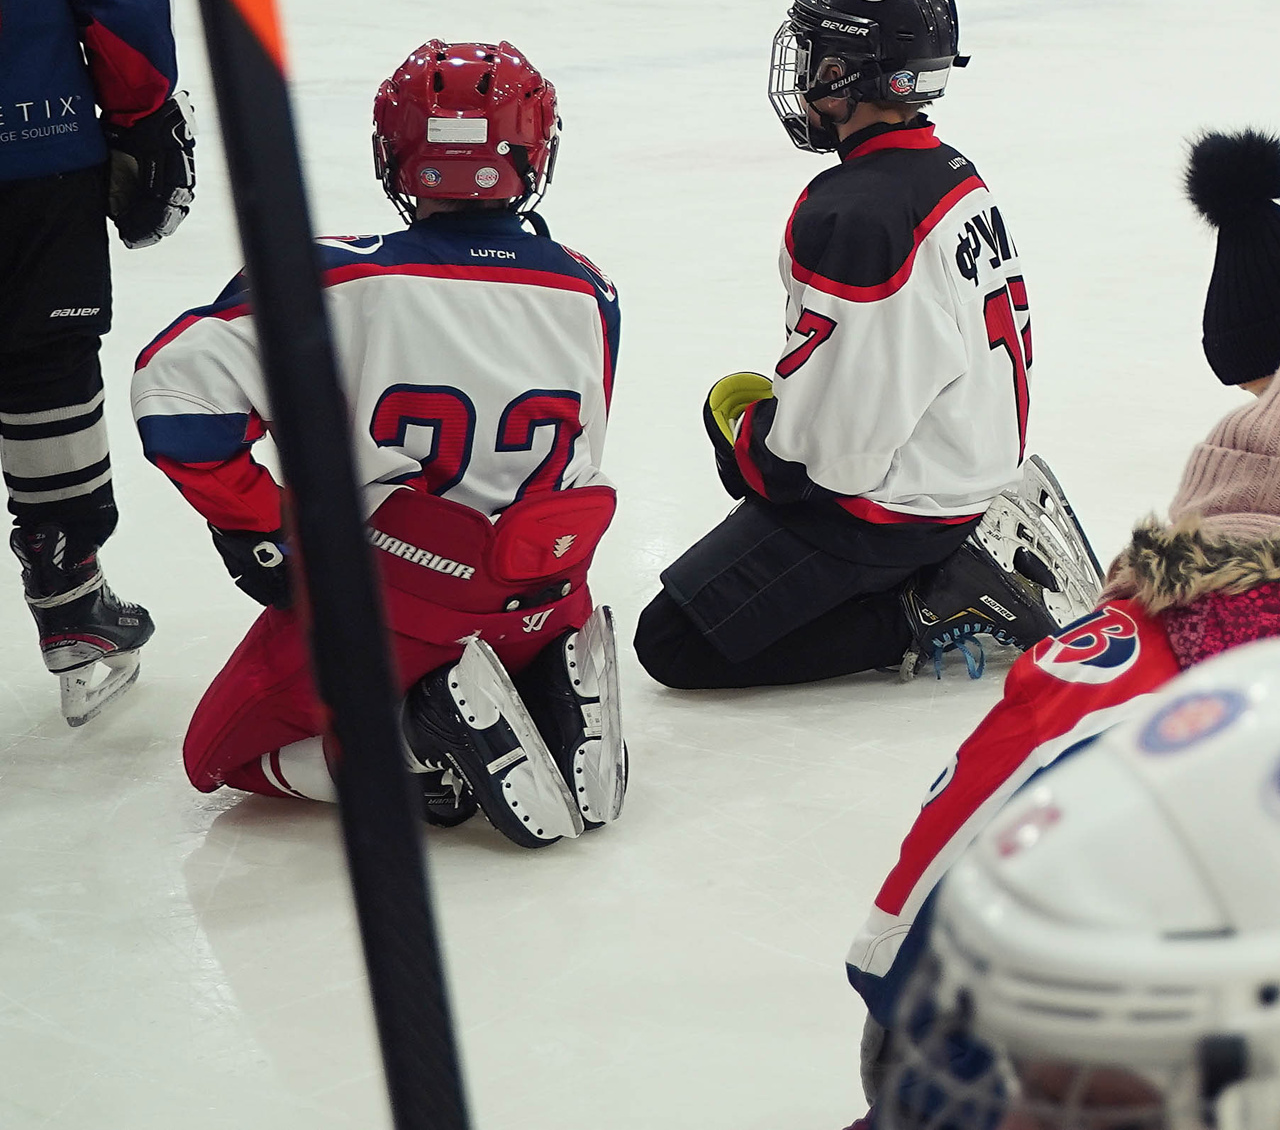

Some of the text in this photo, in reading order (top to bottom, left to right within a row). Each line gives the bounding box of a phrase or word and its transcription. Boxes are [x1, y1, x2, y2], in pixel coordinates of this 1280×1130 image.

[0, 96, 77, 125] TIX
[21, 121, 79, 140] SOLUTIONS
[470, 248, 516, 260] LUTCH
[369, 383, 583, 516] 22
